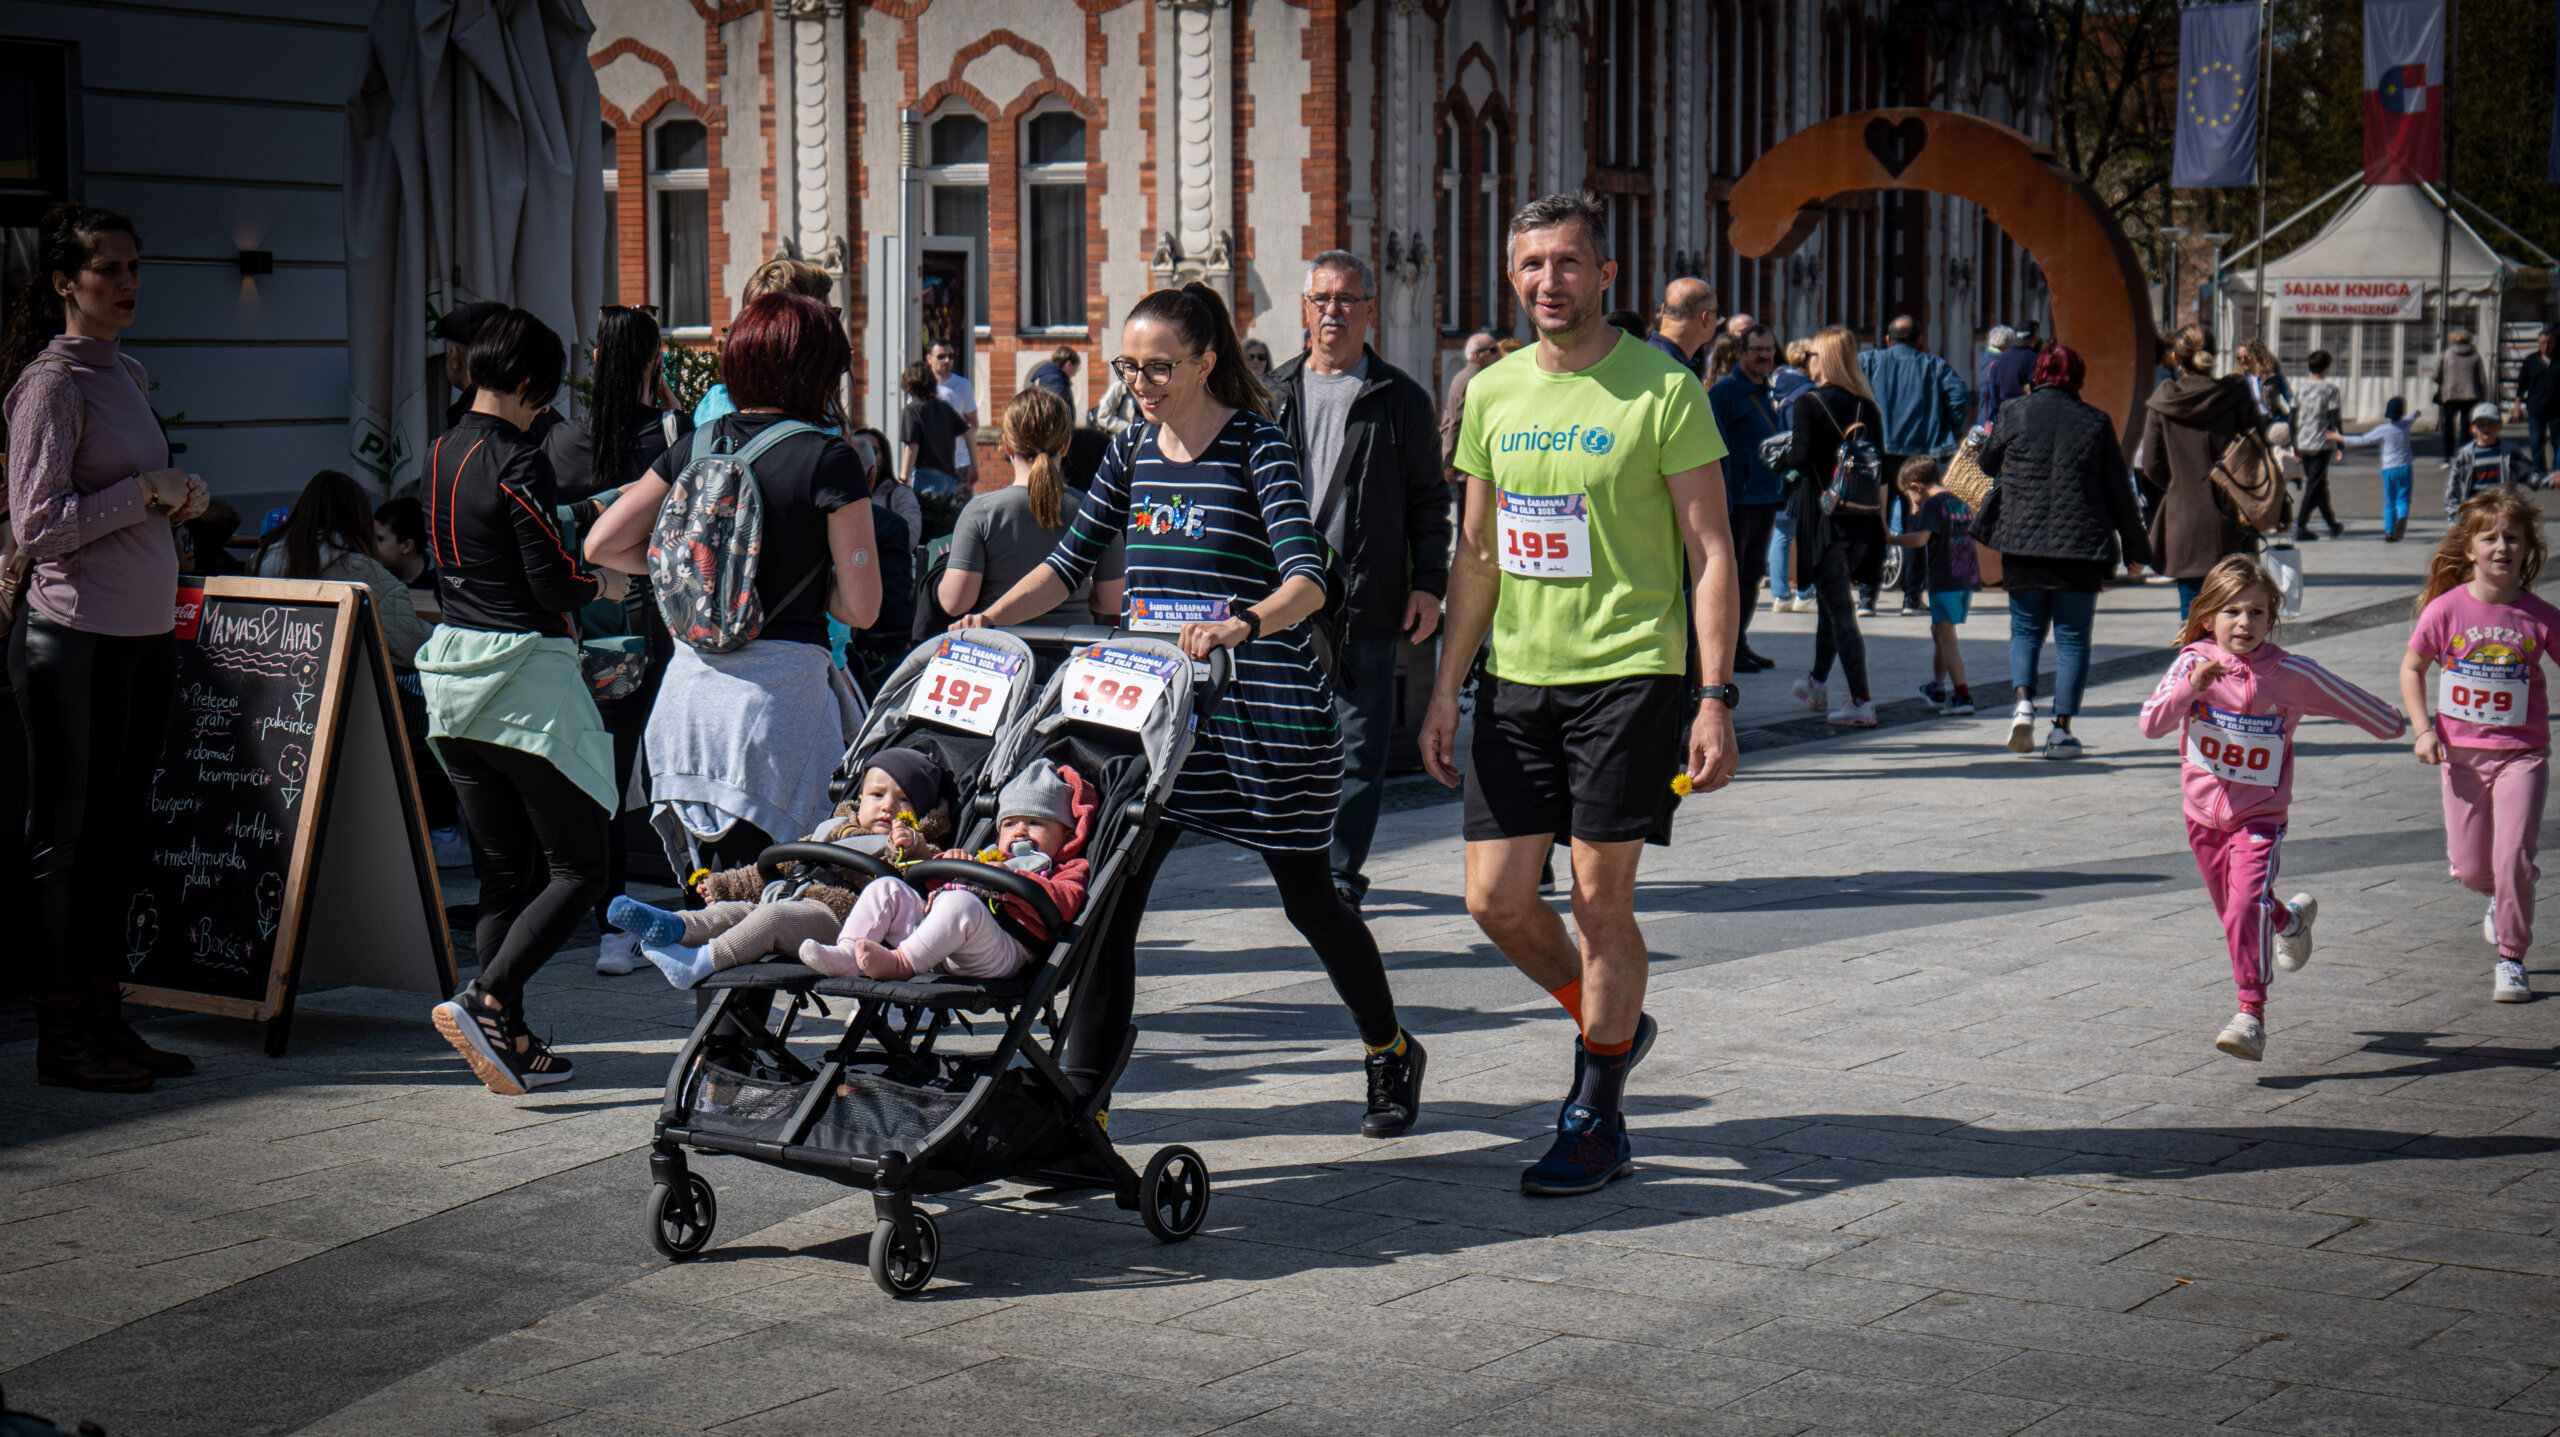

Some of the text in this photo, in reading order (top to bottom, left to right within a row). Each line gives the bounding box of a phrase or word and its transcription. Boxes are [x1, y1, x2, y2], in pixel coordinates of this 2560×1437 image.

[2284, 282, 2411, 299] SAJAM KNJIGA
[2296, 302, 2399, 316] VELIKA SNIŽENJA
[1501, 424, 1580, 453] unicef
[1134, 493, 1207, 540] LOVE
[1508, 528, 1569, 559] 195
[1175, 602, 1211, 612] ČARAPAMA
[928, 675, 992, 712] 197
[1074, 674, 1143, 711] 198
[2452, 685, 2513, 712] 079
[195, 713, 225, 738] grah
[262, 706, 314, 741] palačinke
[2201, 736, 2271, 771] 080
